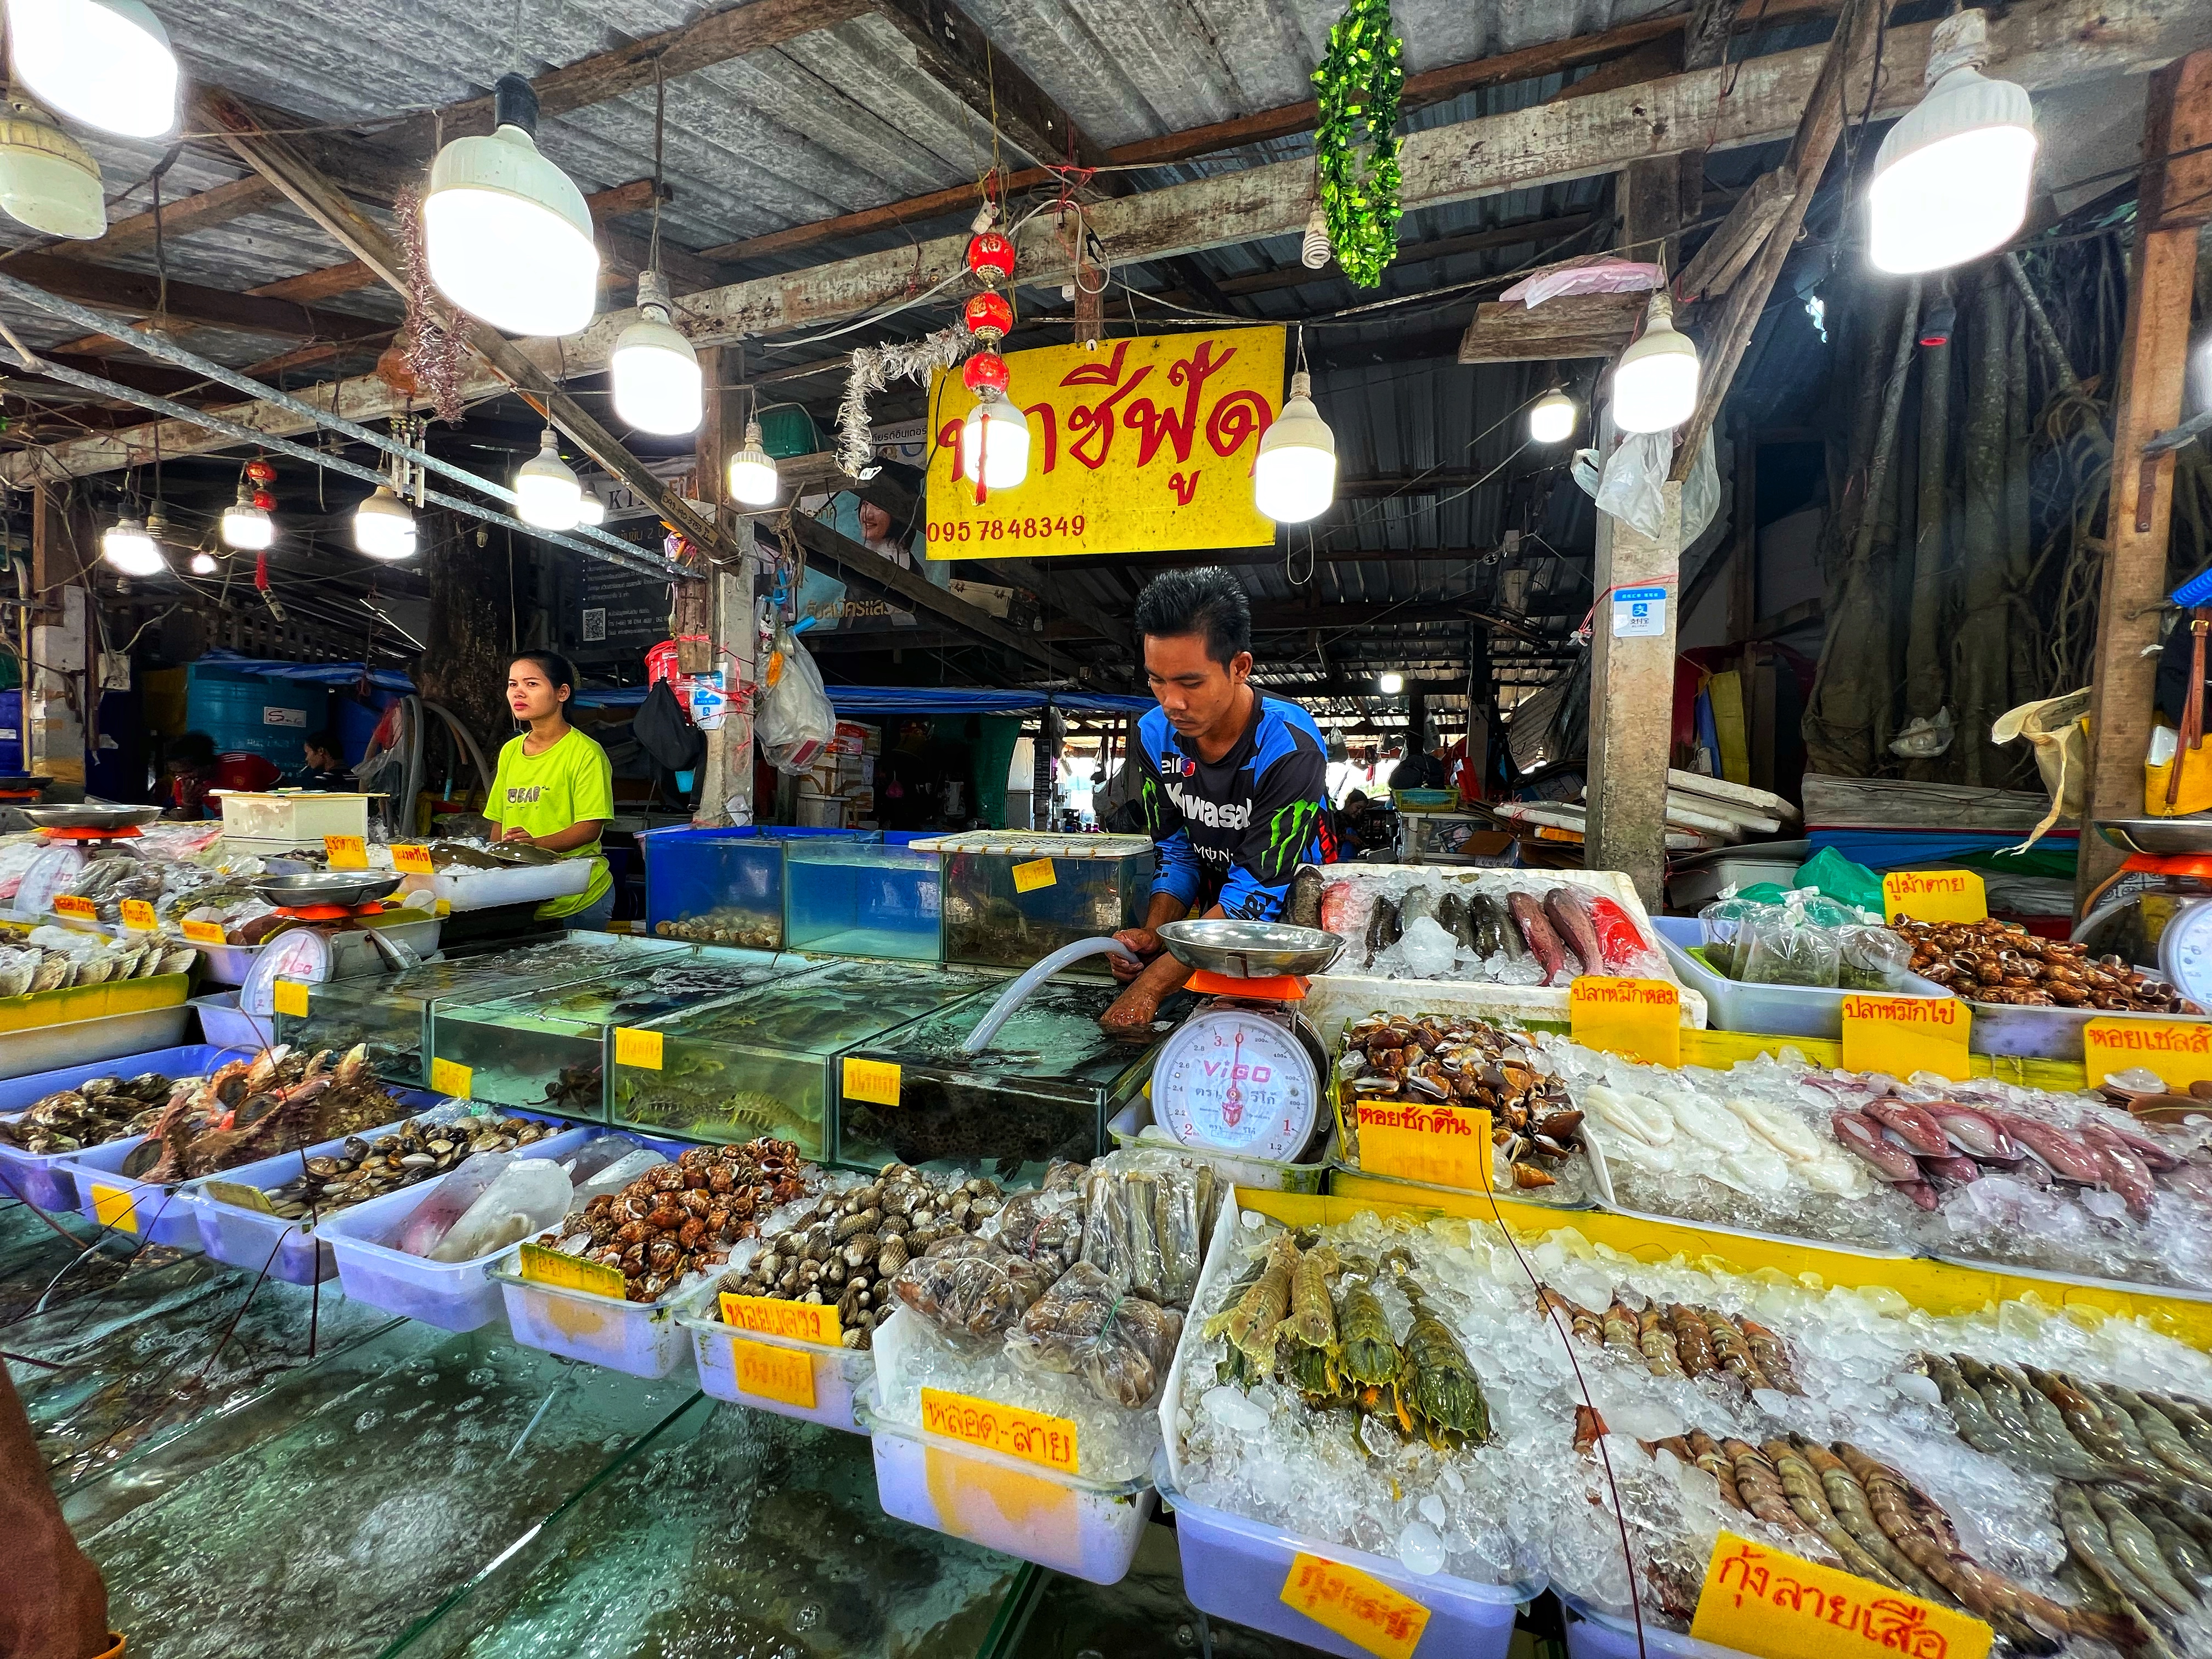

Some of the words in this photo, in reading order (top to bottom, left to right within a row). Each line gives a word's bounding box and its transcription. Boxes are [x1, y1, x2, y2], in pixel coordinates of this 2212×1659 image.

[1193, 843, 1233, 862] MON
[1887, 873, 1965, 901] ปูม้าตาย
[1573, 980, 1680, 1006] ปลาหมึกหอม
[1844, 998, 1955, 1025] ปลาหมึกไข่
[1358, 1106, 1471, 1136] หอยชักตีน
